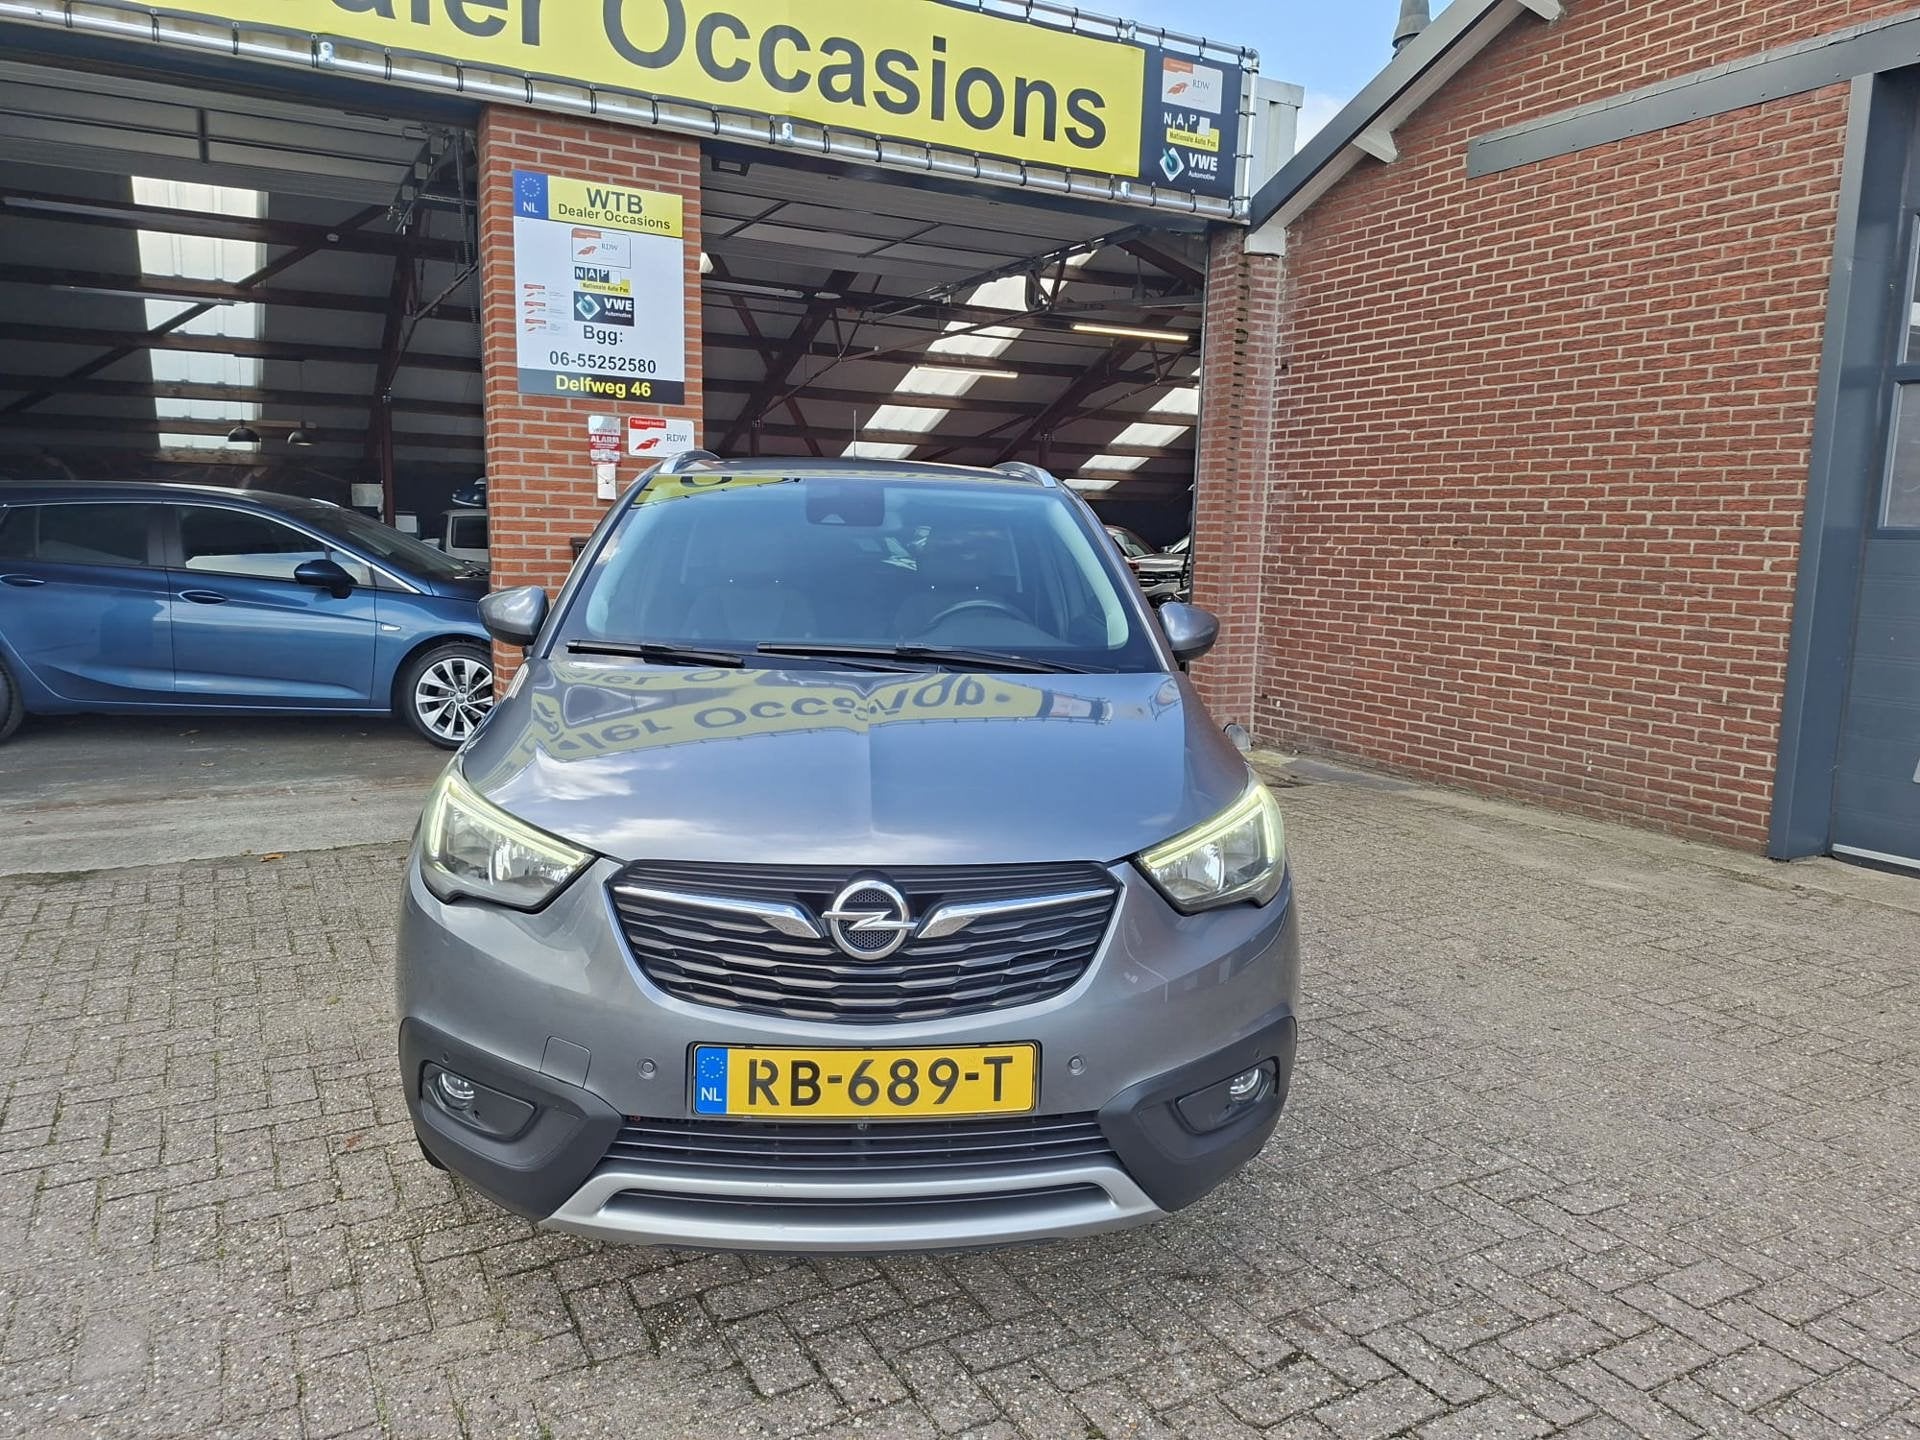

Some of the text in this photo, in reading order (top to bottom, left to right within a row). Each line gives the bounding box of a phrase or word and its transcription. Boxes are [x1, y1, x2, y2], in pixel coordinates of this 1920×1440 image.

[603, 0, 1107, 149] Occasions
[1188, 152, 1218, 171] VWE
[523, 201, 539, 213] NL
[586, 187, 643, 214] WTB
[558, 203, 671, 230] Dealer Occasions
[603, 297, 633, 311] VWE
[583, 325, 623, 345] Bgg:
[549, 351, 656, 374] 06-55252580
[556, 375, 652, 398] Delfweg 46
[590, 434, 620, 444] ALARM
[666, 433, 688, 442] RDW
[748, 1056, 1014, 1107] RB-689-T
[701, 1087, 722, 1102] NL
